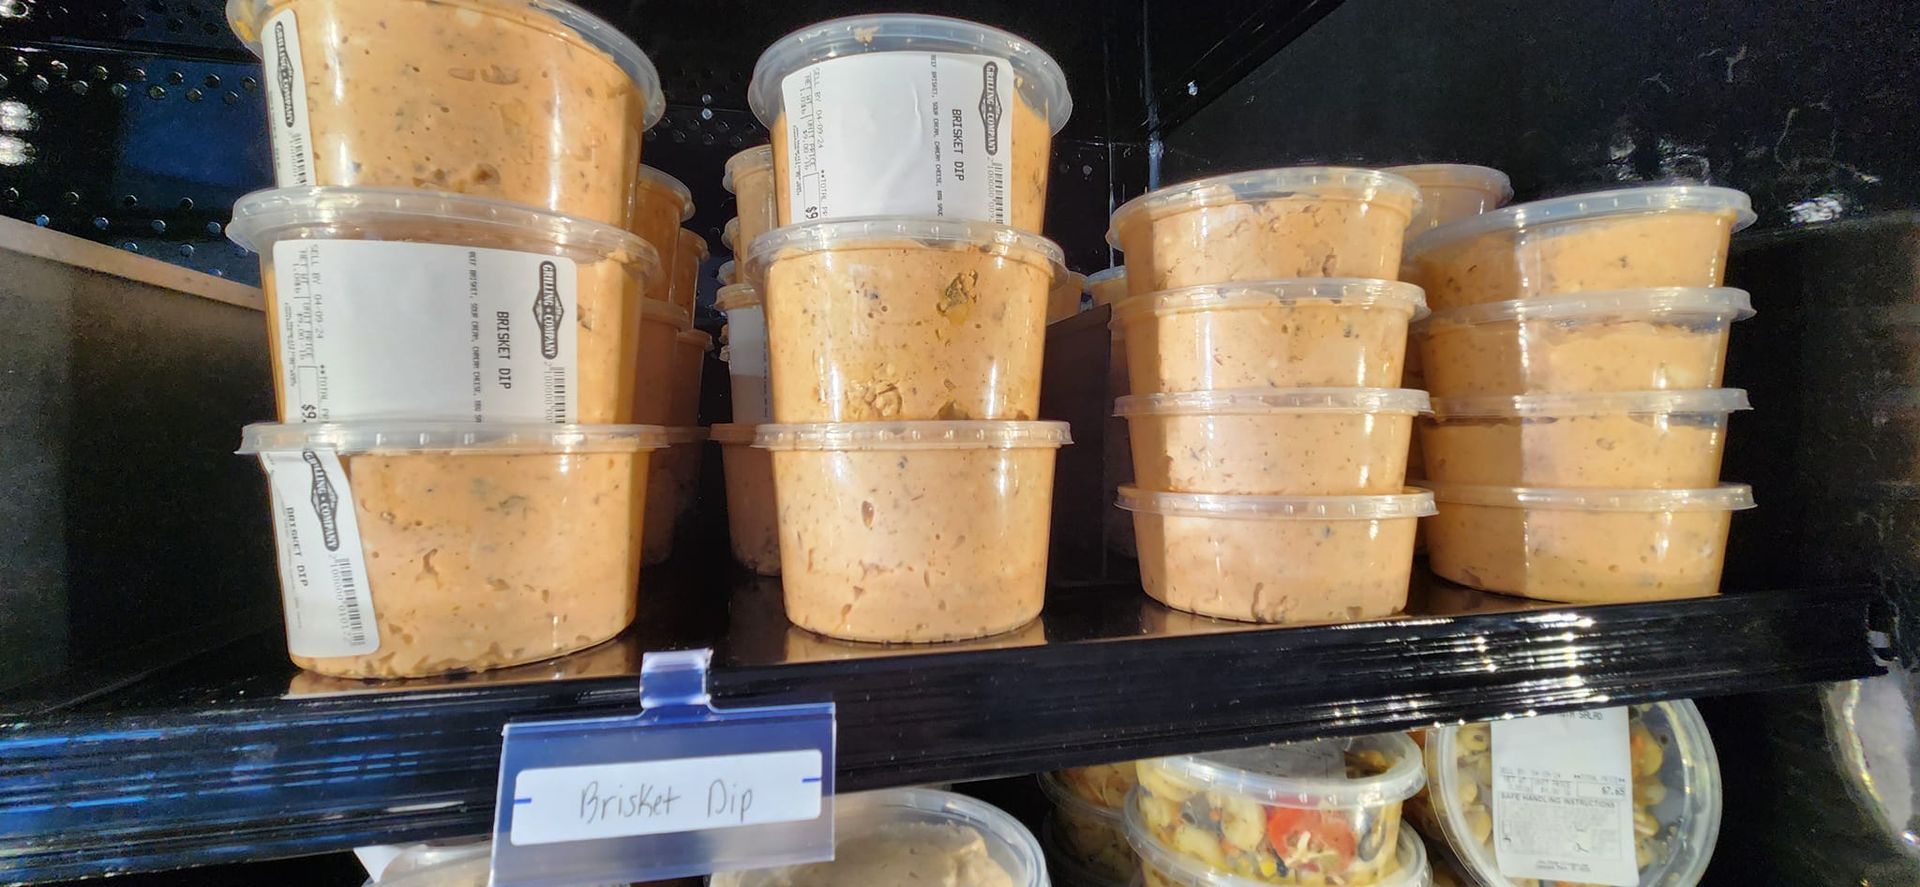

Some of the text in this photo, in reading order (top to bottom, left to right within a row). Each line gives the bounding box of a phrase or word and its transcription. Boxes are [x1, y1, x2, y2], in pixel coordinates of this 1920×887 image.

[275, 26, 288, 69] GRILLING
[282, 78, 294, 124] COMPANY
[984, 65, 997, 153] GRILLING COMPANY
[952, 109, 965, 182] BRISKET DIP
[496, 311, 512, 390] BRISKET DIP
[542, 264, 555, 357] GRILLING COMPANY
[304, 451, 337, 549] GRILLING COMPANY
[297, 564, 310, 588] DIP
[705, 778, 755, 824] Dip
